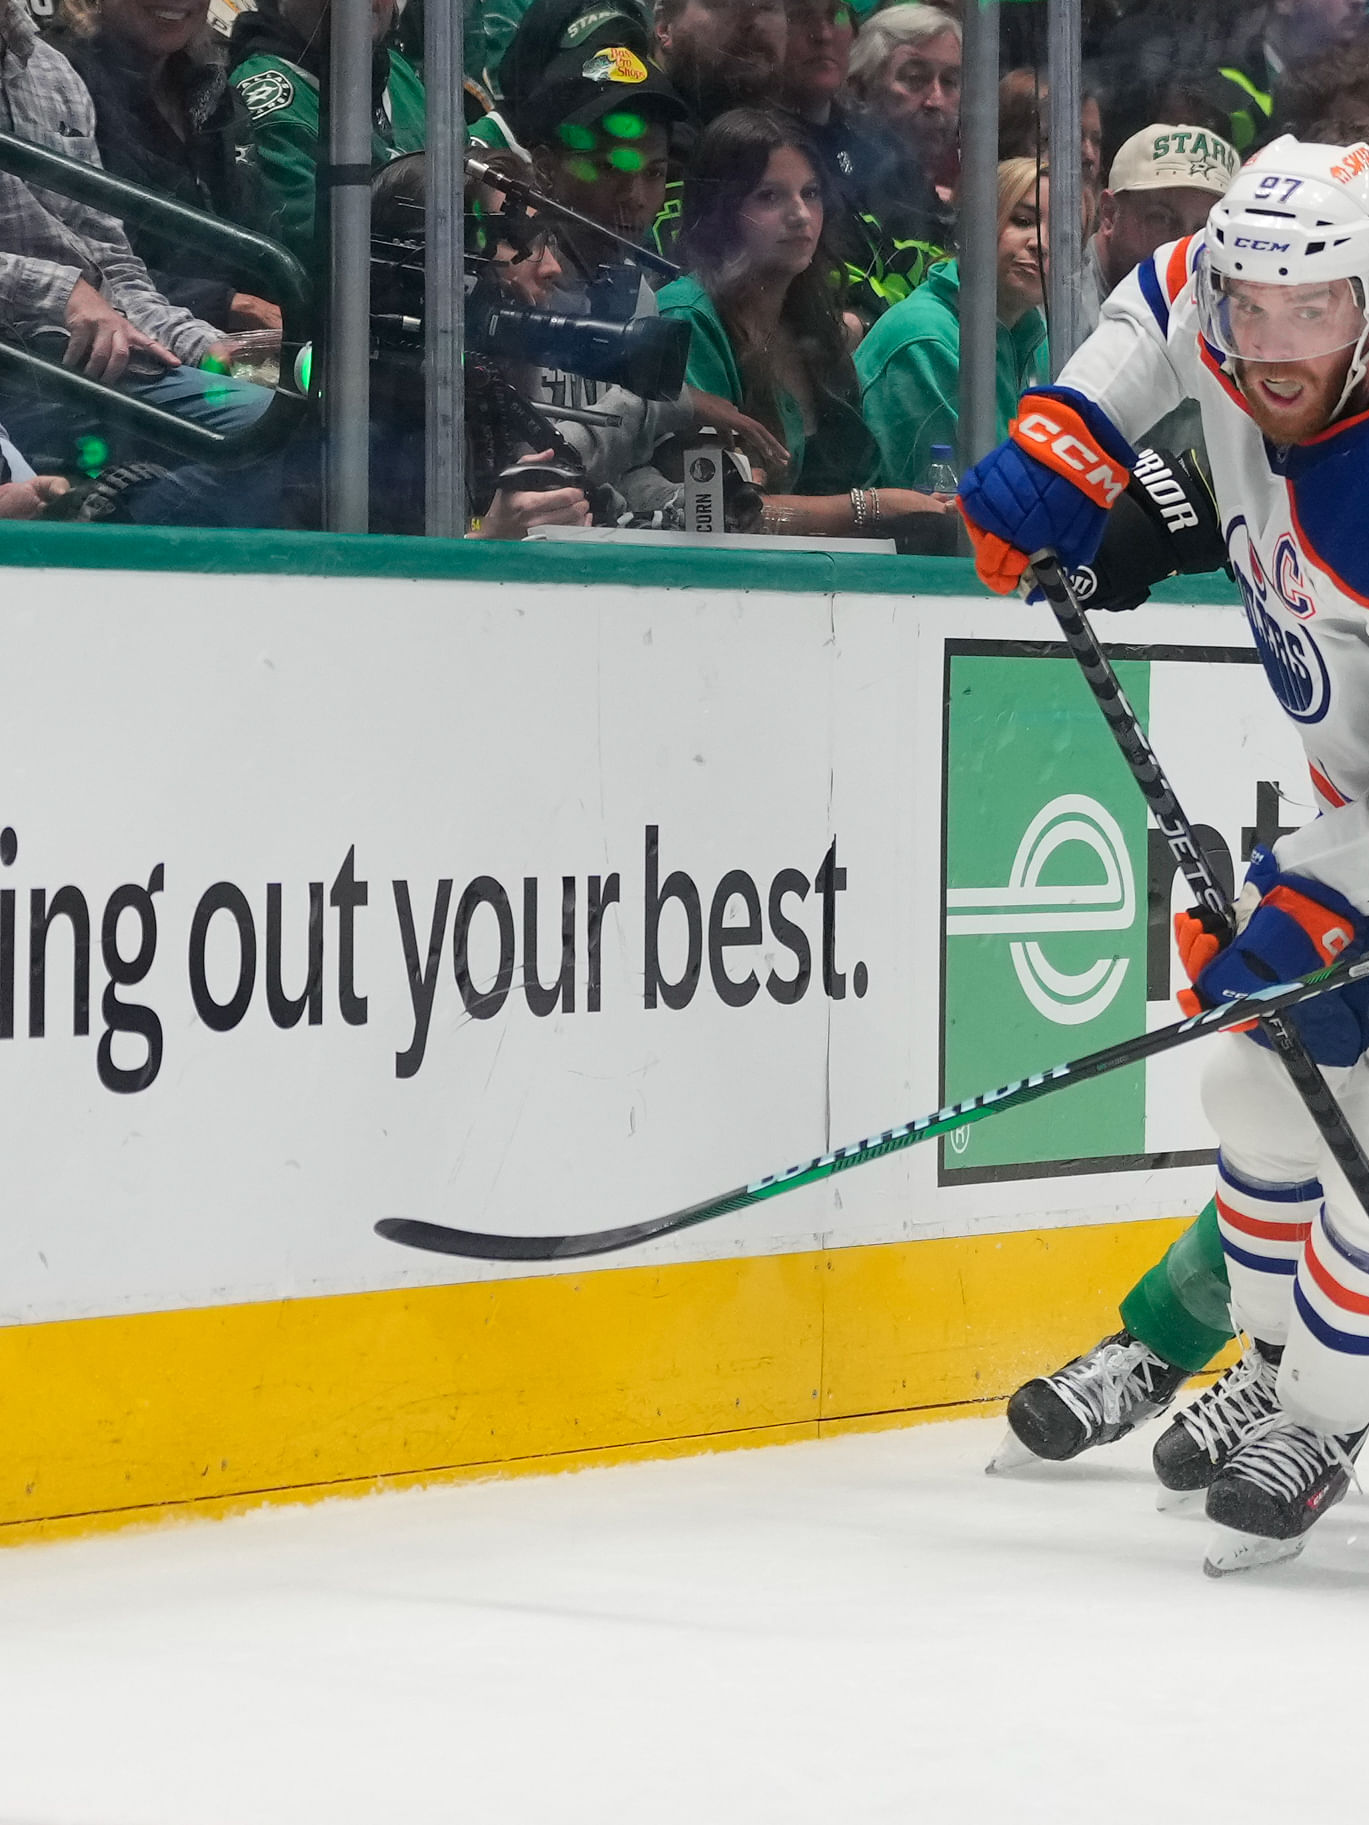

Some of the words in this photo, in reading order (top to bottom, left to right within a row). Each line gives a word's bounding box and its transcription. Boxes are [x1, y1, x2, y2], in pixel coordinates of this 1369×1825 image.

[617, 66, 646, 80] Shops
[1254, 175, 1303, 204] 97
[1233, 236, 1290, 253] CCM
[1019, 413, 1123, 503] CCM
[1272, 531, 1316, 620] C
[189, 843, 369, 1032] out
[392, 872, 621, 1080] your
[643, 825, 869, 1009] best.
[1222, 989, 1251, 1001] CC
